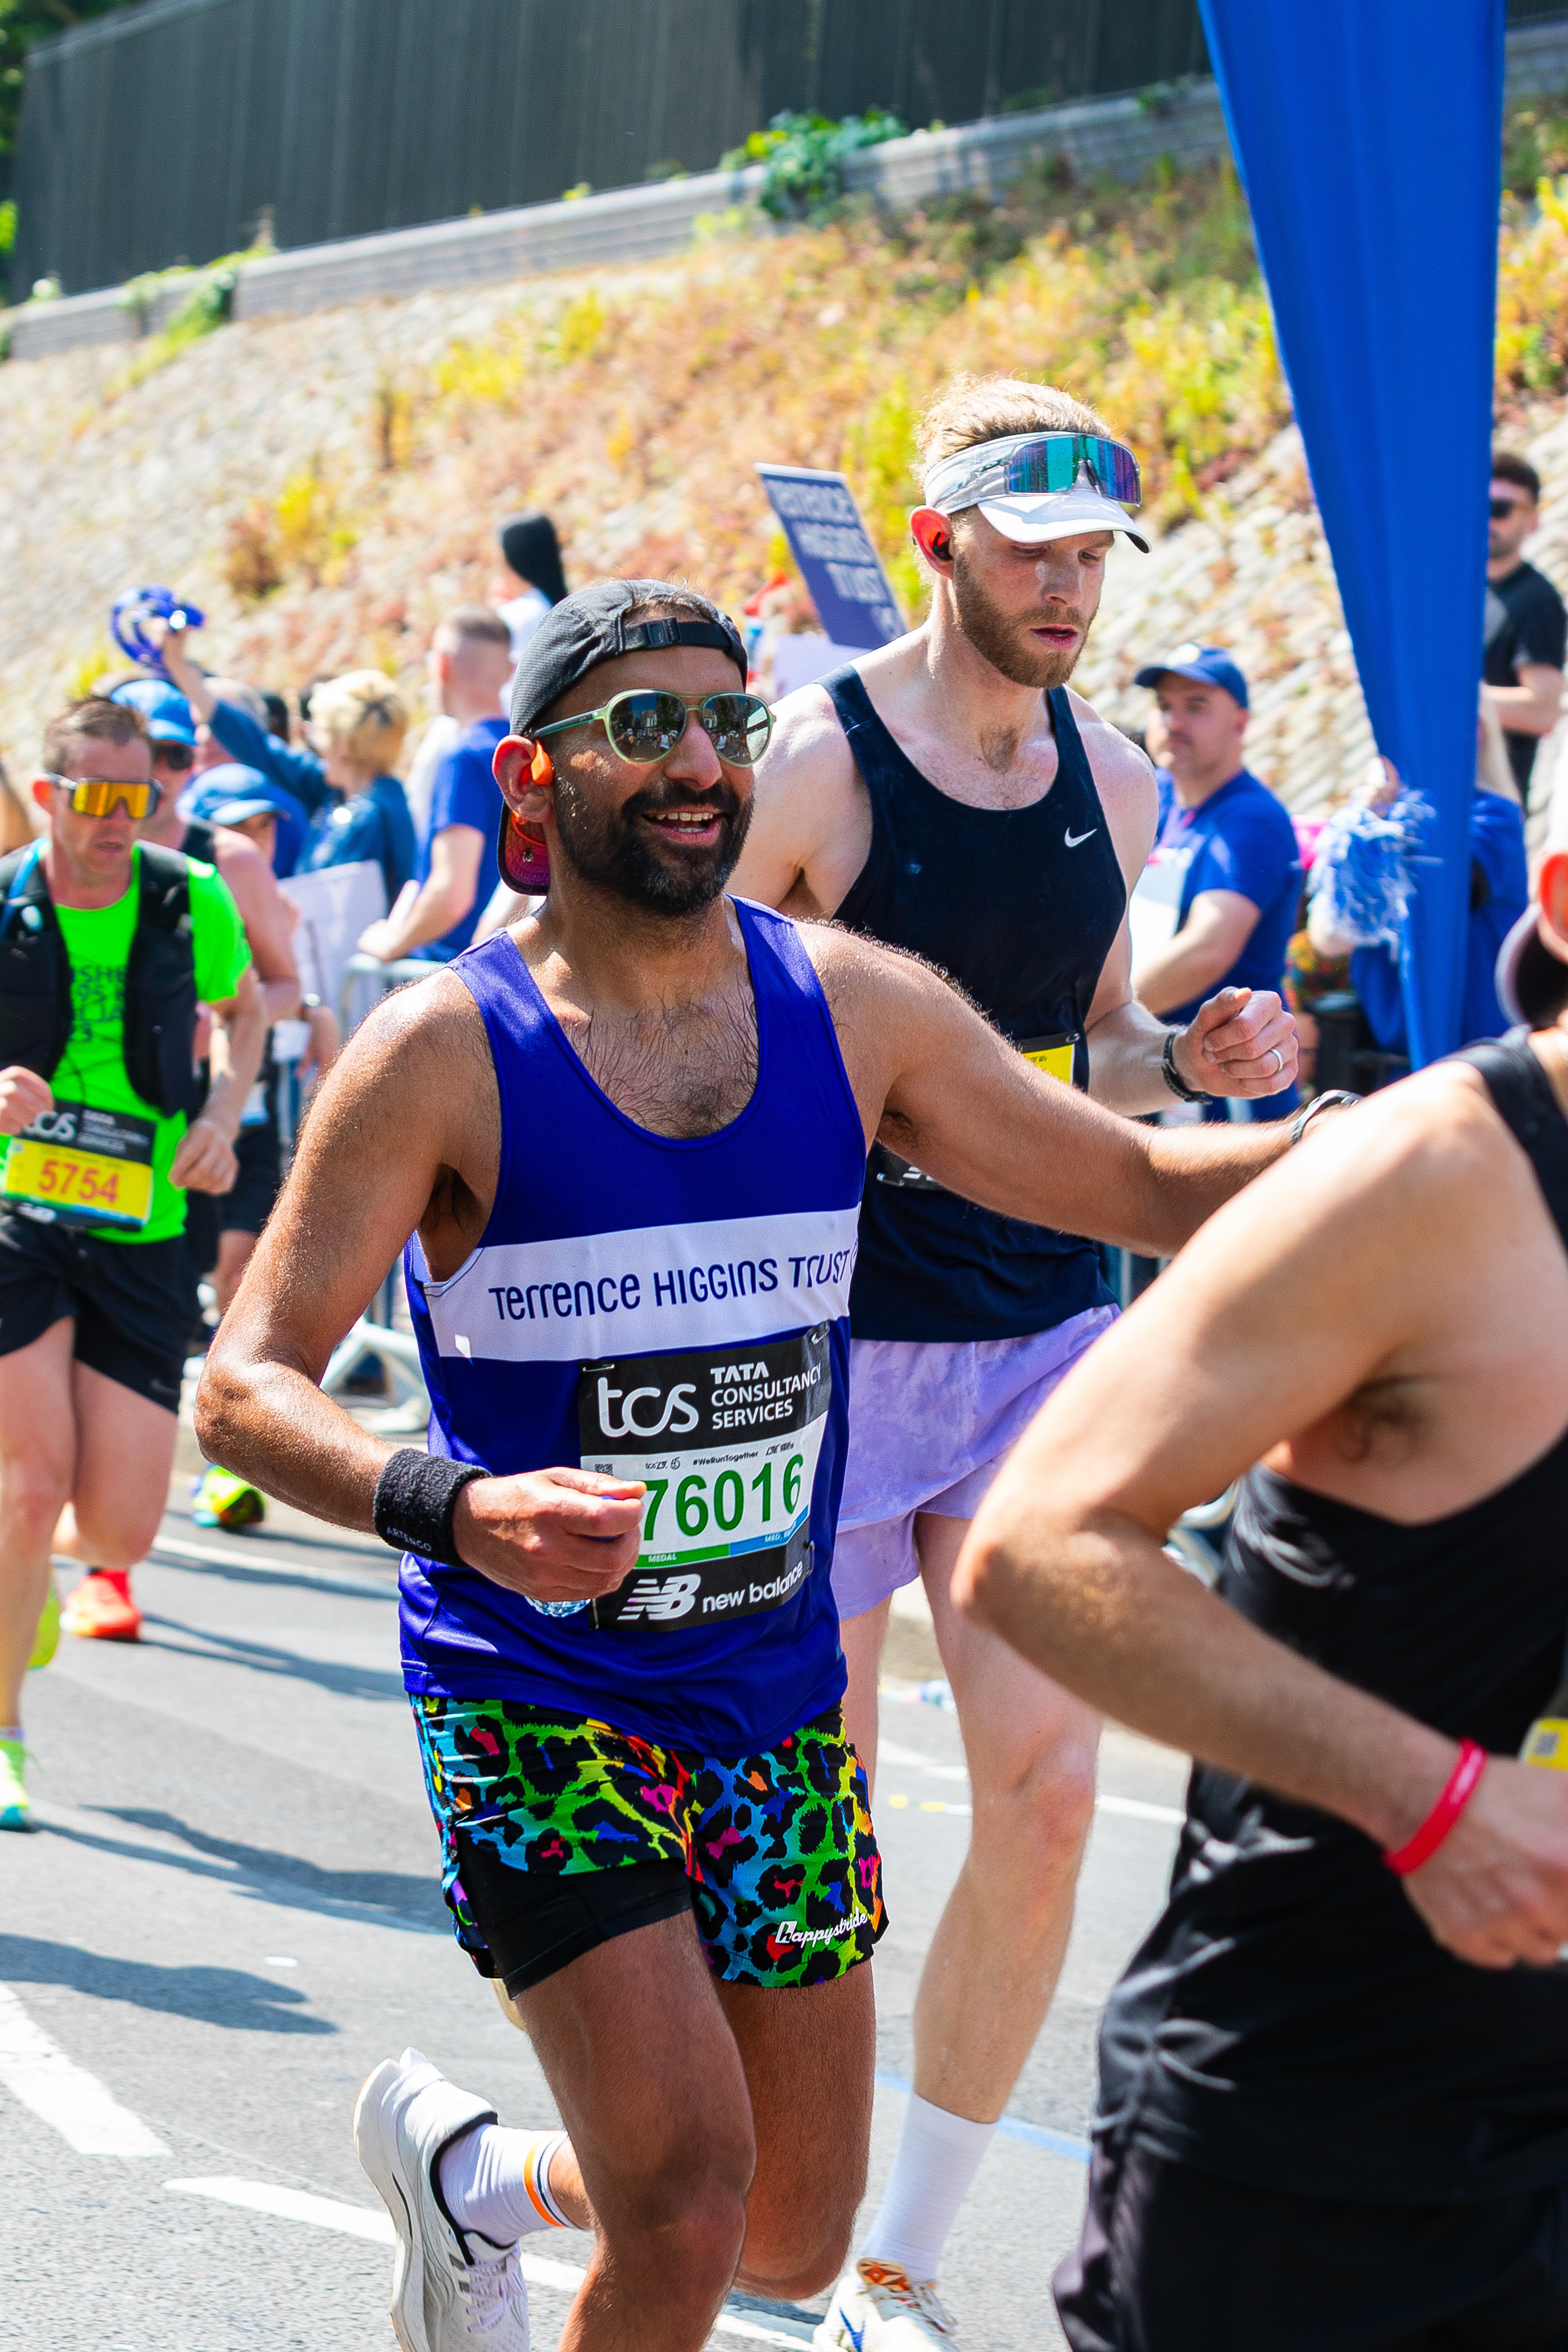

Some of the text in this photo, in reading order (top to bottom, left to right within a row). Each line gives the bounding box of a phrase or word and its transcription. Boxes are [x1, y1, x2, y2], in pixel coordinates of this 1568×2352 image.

[38, 1158, 119, 1204] 5754
[710, 1361, 769, 1384] TATA
[711, 1362, 821, 1407] CONSULTANCY
[598, 1377, 699, 1437] tcs
[712, 1399, 793, 1430] SERVICES
[640, 1454, 803, 1540] 76016
[648, 1553, 677, 1563] MEDAL
[702, 1561, 803, 1613] new balance
